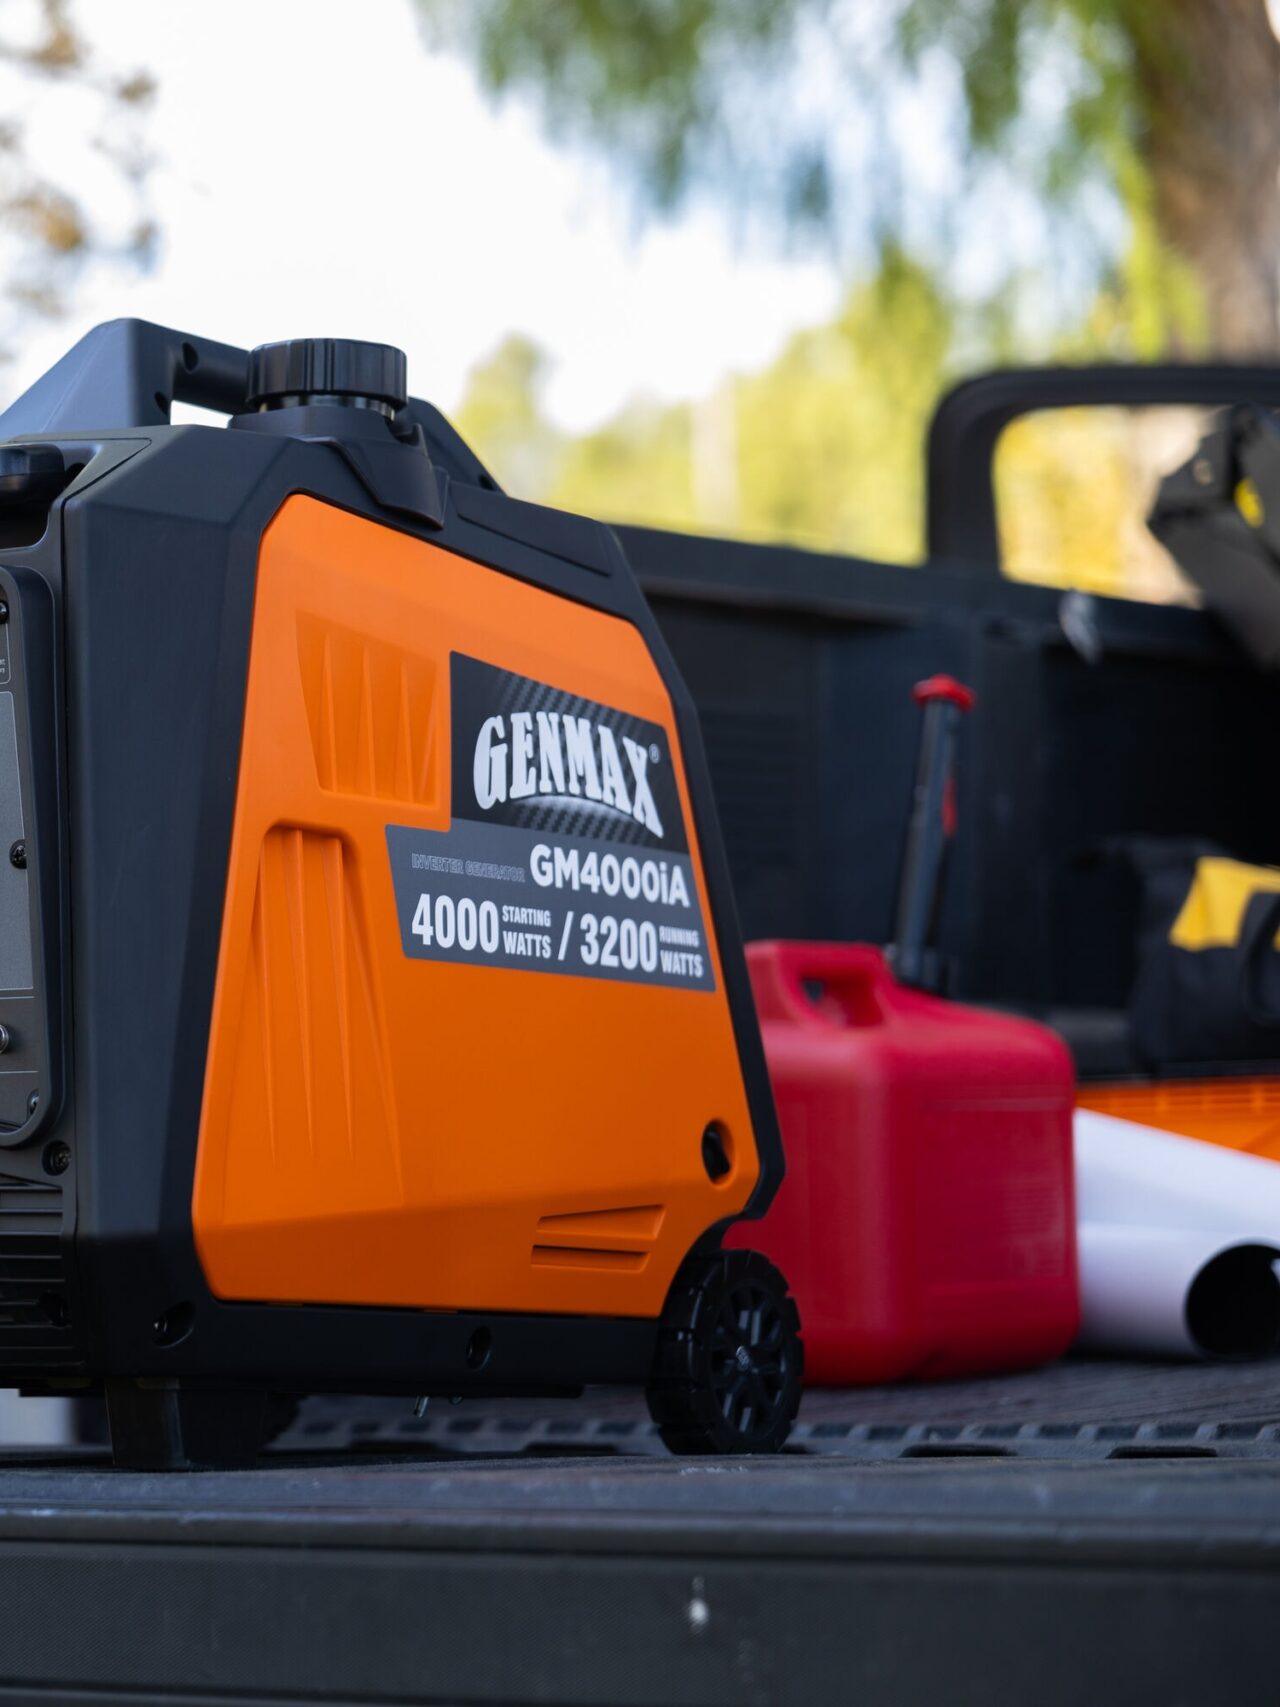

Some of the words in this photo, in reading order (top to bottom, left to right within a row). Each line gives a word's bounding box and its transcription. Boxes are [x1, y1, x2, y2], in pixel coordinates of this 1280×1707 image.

[473, 711, 664, 838] GENMAX
[412, 853, 464, 874] INVERTER
[465, 860, 525, 882] GENERATOR
[530, 844, 690, 908] GM4000iA
[412, 893, 499, 953] 4000
[502, 905, 551, 927] STARTING
[503, 930, 551, 959] WATTS
[580, 913, 658, 972] 3200
[659, 926, 699, 948] RUNNING
[660, 950, 703, 978] WATTS
